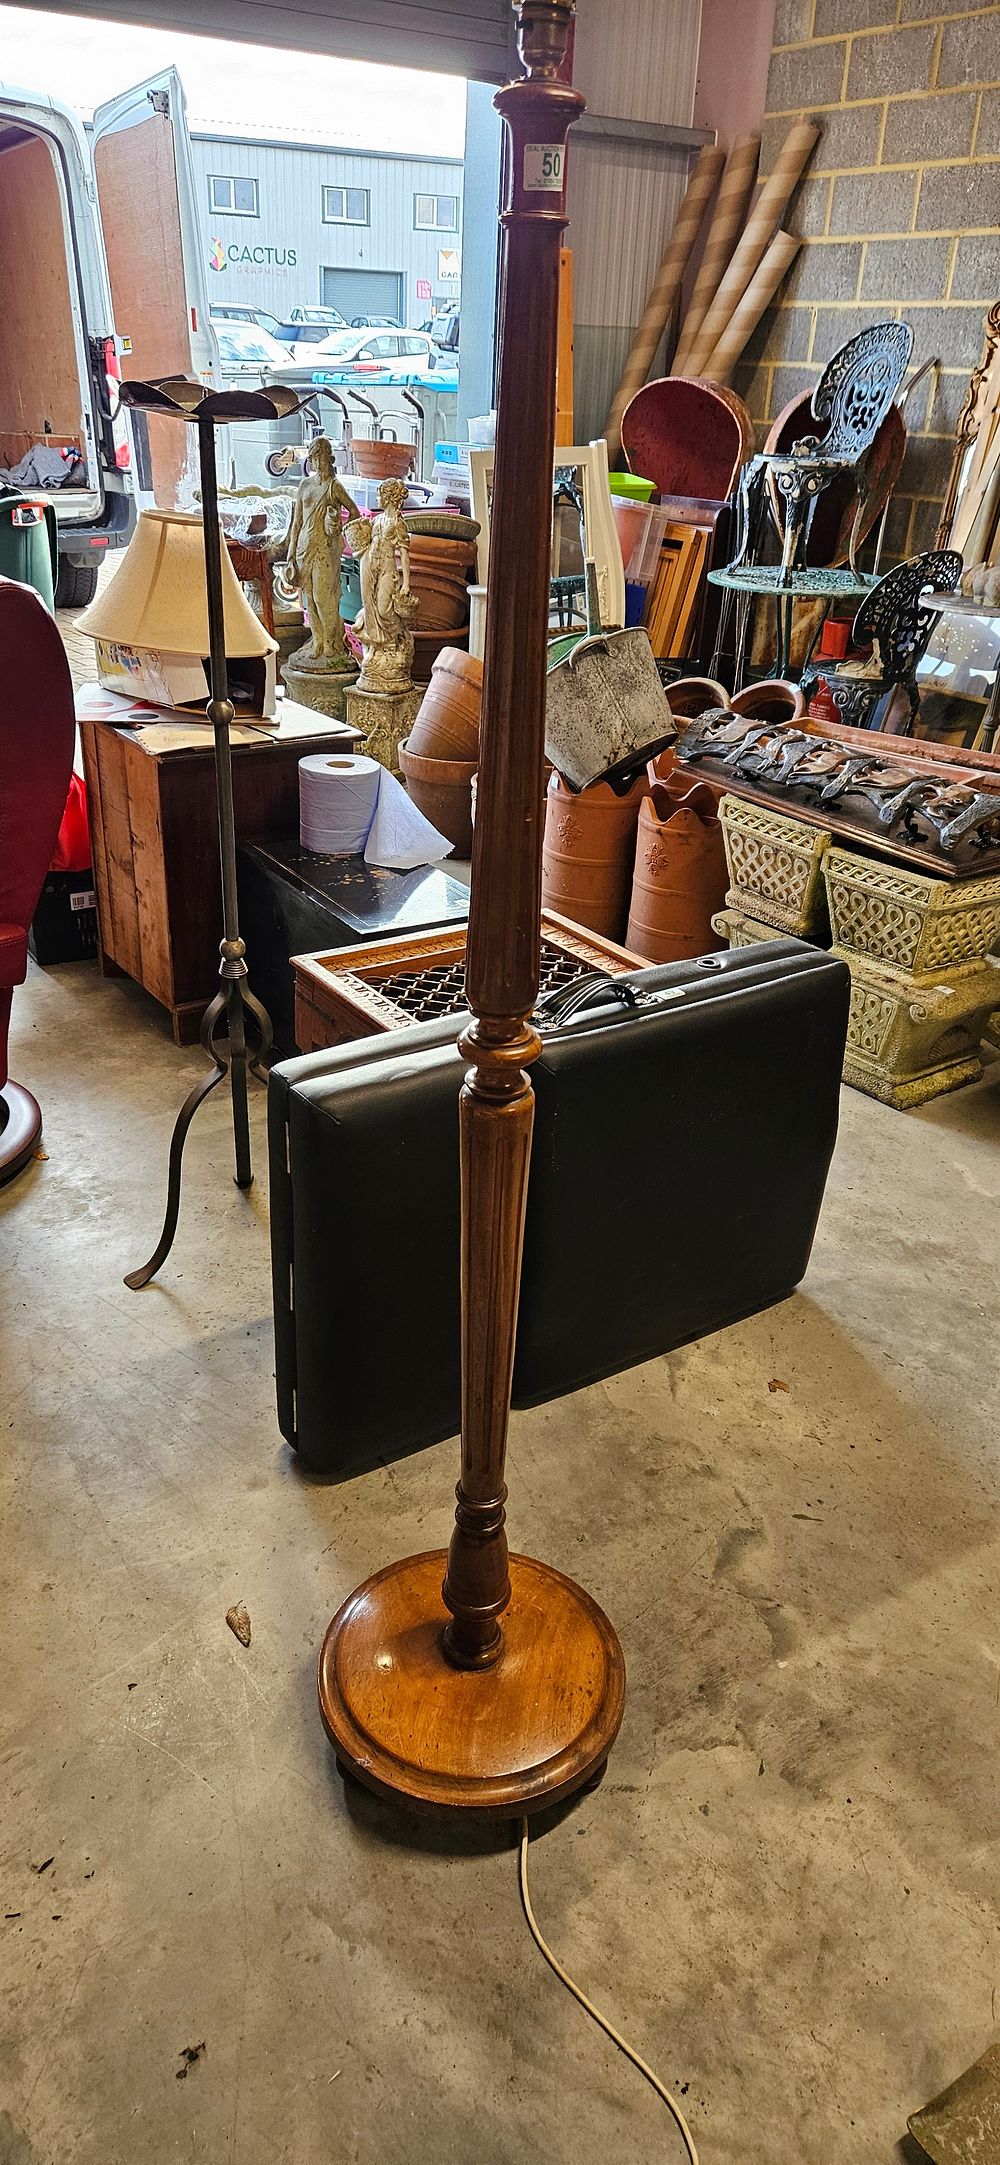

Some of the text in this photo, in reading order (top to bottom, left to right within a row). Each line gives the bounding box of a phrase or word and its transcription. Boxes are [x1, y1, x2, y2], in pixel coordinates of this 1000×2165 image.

[542, 152, 561, 178] 50
[227, 244, 297, 266] CACTUS
[236, 264, 288, 277] GRAPHICS
